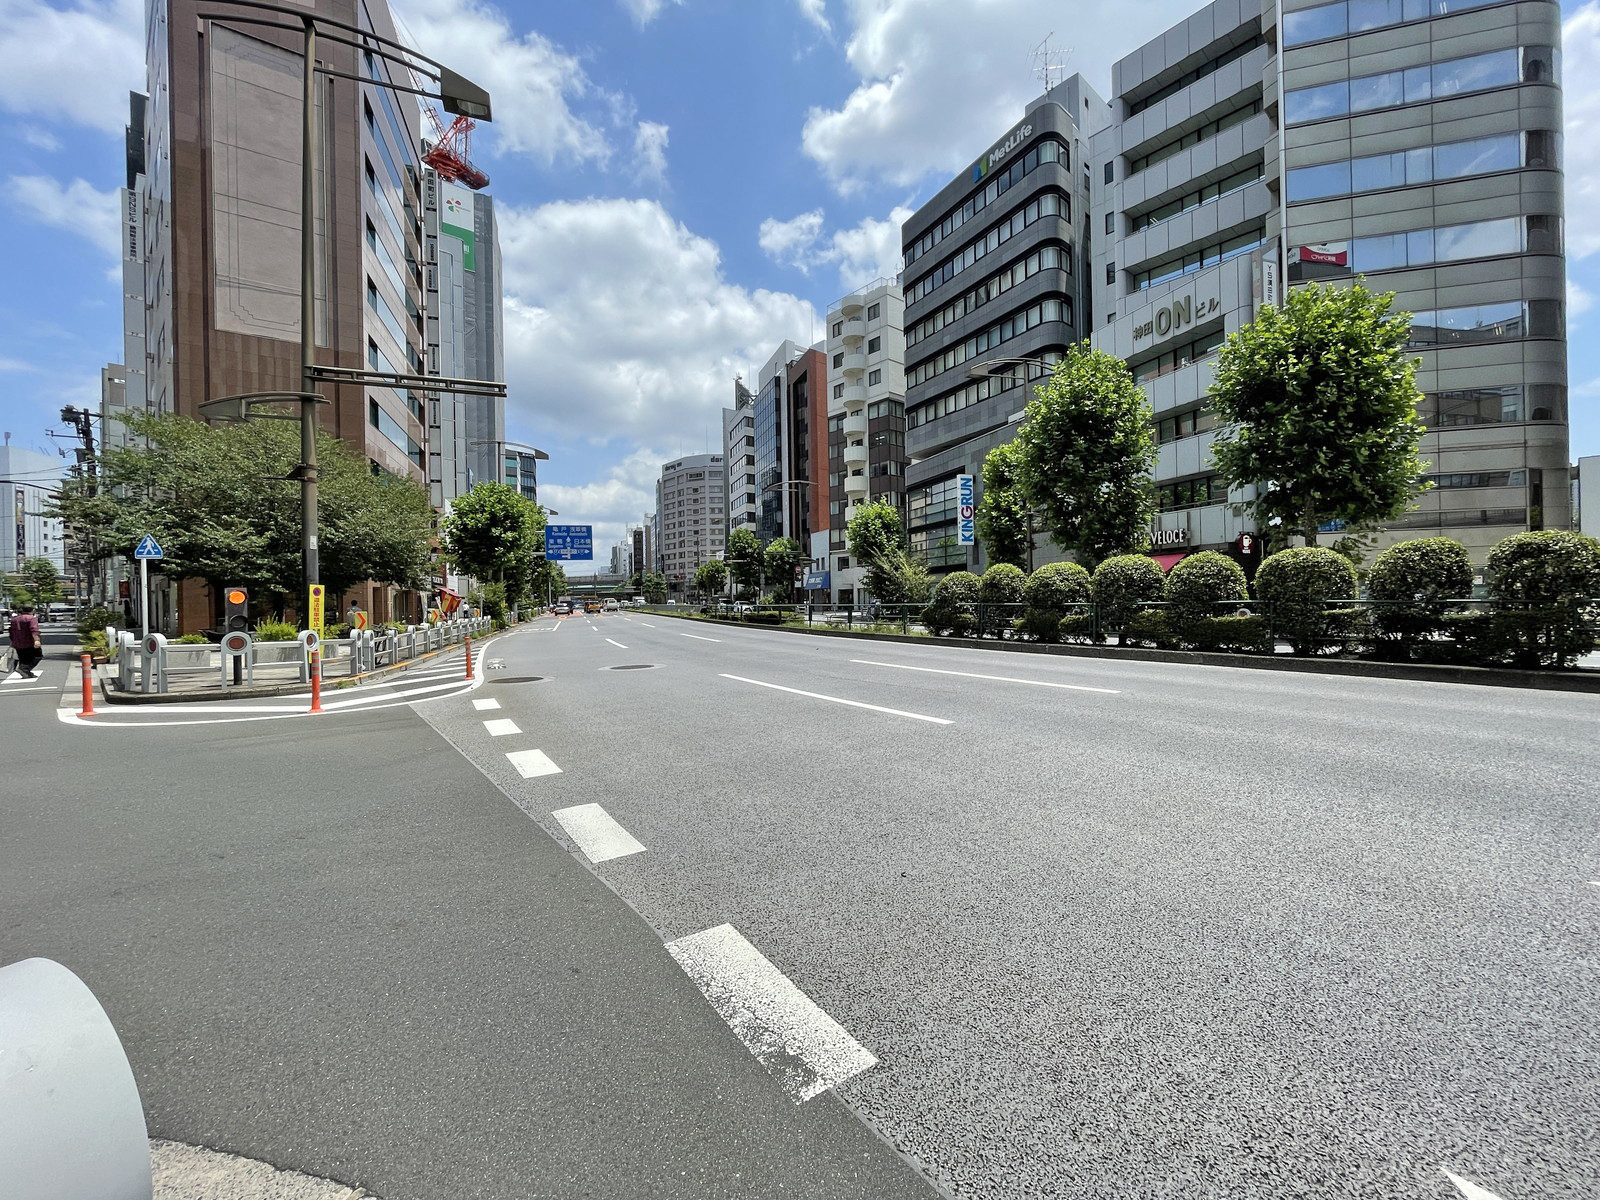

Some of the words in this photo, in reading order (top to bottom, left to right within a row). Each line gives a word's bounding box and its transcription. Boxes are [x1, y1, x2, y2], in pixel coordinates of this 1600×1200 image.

[989, 123, 1033, 167] MetLife
[1133, 295, 1219, 341] 神田ONビル
[960, 477, 974, 543] KINGRUN
[1150, 528, 1184, 545] VELOCE
